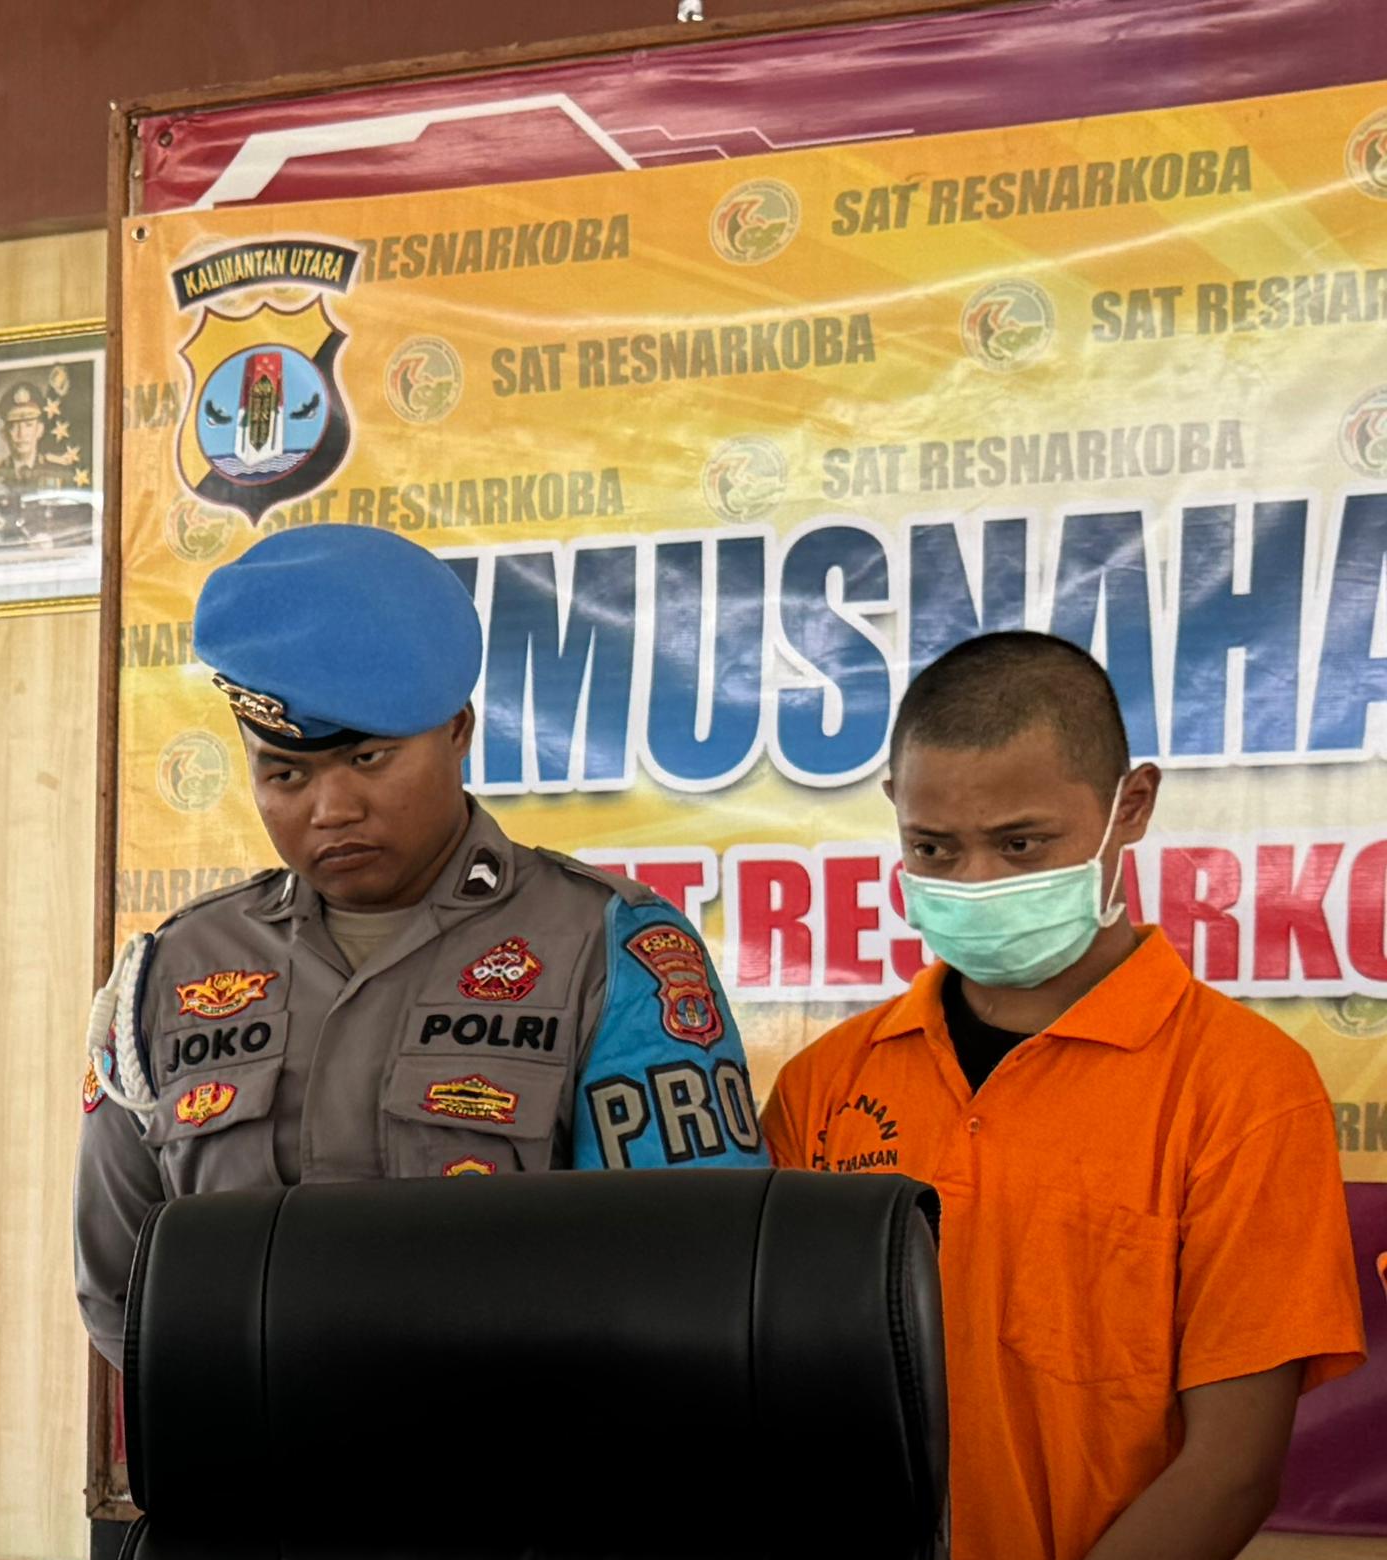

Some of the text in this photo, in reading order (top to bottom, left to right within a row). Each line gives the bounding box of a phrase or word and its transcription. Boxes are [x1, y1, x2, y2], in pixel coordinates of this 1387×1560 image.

[831, 183, 920, 237] SAT
[926, 146, 1252, 226] RESNARKOBA
[183, 248, 346, 298] KALIMANTAN UTARA
[1092, 286, 1183, 344] SAT
[491, 313, 877, 397] SAT RESNARKOBA
[821, 420, 1246, 499] SAT RESNARKOBA
[346, 467, 626, 531] RESNARKOBA
[167, 1021, 272, 1073] JOKO
[420, 1014, 559, 1051] POLRI
